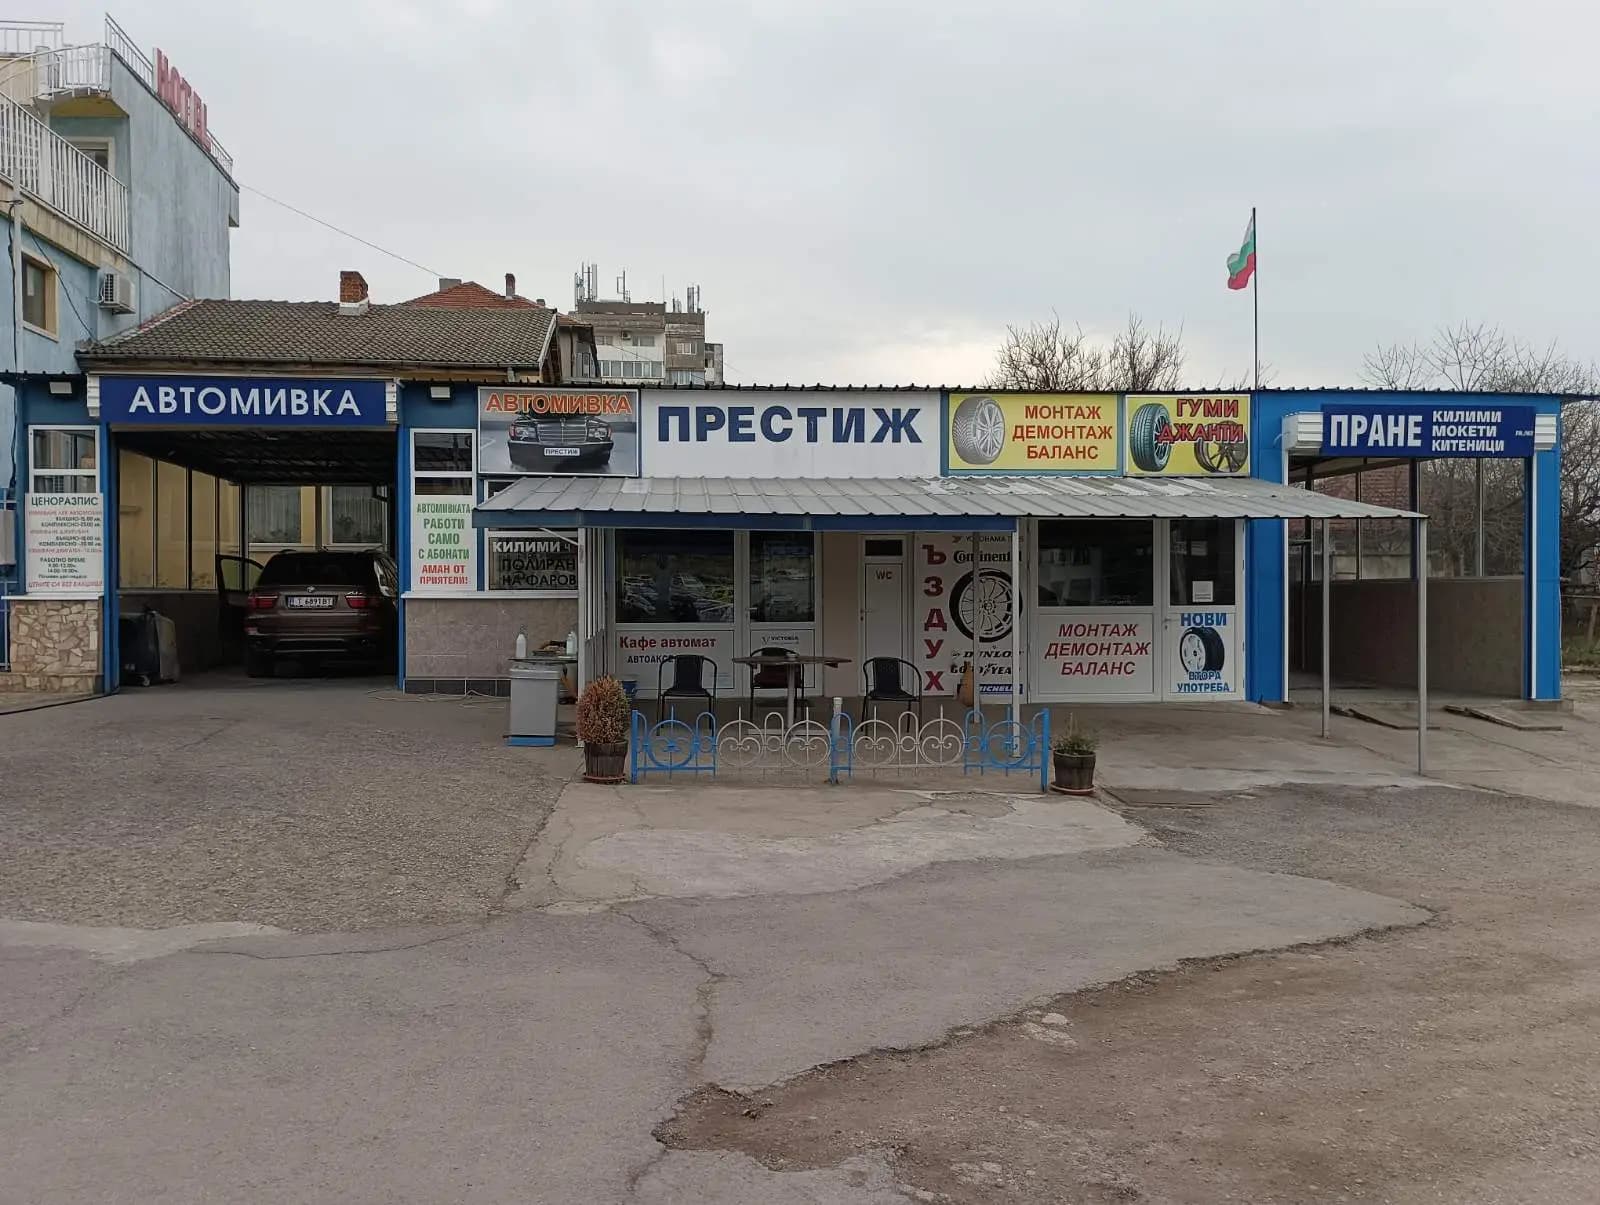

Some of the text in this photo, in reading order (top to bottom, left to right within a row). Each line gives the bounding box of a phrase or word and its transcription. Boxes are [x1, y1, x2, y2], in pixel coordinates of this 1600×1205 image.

[155, 48, 211, 152] HOTEL
[128, 386, 361, 416] АВТОМИВКА
[485, 392, 632, 415] АВТОМИВКА
[1024, 405, 1101, 420] МОНТАЖ
[1176, 399, 1239, 418] ГУМИ
[1432, 410, 1501, 423] КИЛИМИ
[658, 405, 922, 443] ПРЕСТИЖ
[1330, 414, 1423, 447] ПРАНЕ
[1432, 425, 1497, 437] МОКЕТИ
[1012, 425, 1113, 441] ДЕМОНТАЖ
[1158, 423, 1244, 444] ДЖАНТИ
[1026, 445, 1099, 460] БАЛАНС
[1432, 439, 1504, 454] КИТЕНИЦИ
[31, 496, 98, 507] ЦЕНОРАЗПИС
[416, 503, 471, 514] АВТОМИВКАТА
[423, 518, 465, 529] РАБОТИ
[428, 532, 460, 545] САМО
[965, 535, 1005, 543] YOOHAMA
[418, 548, 470, 560] С АБОНАТИ
[492, 541, 561, 553] КИЛИМИ
[953, 550, 1022, 564] Coninentl
[421, 564, 465, 574] АМАН ОТ
[875, 569, 893, 580] WC
[419, 576, 468, 585] ПРИЯТЕЛИ!
[1180, 613, 1227, 627] НОВИ
[1058, 623, 1138, 637] МОНТАЖ
[619, 635, 717, 651] Кафе автомат
[1044, 642, 1151, 659] ДЕМОНТАЖ
[1060, 661, 1136, 675] БАЛАНС
[1188, 670, 1222, 681] ВТОРА
[1176, 682, 1230, 693] УПОТРЕБА
